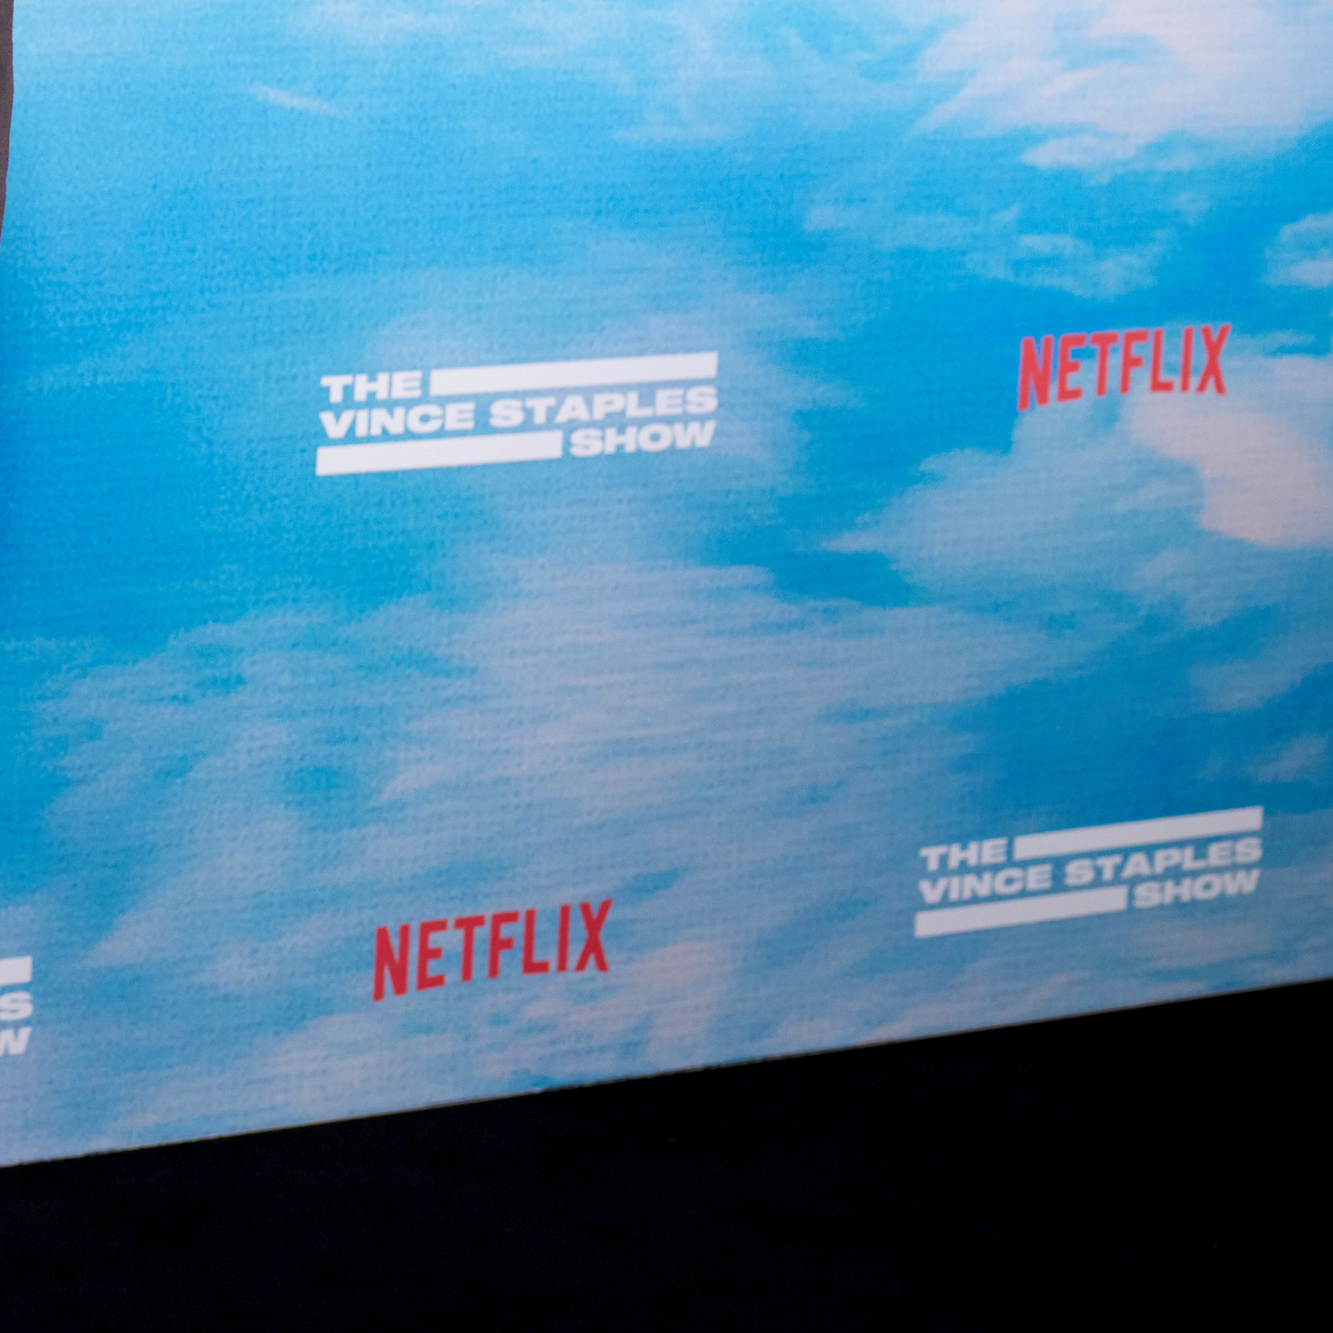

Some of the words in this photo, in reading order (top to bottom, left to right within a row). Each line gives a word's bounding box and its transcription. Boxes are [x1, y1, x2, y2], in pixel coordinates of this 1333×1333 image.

[319, 369, 423, 404] THE
[1019, 323, 1232, 410] NETFLIX
[319, 400, 475, 440] VINCE
[489, 384, 719, 430] STAPLES
[569, 419, 718, 458] SHOW
[917, 863, 1052, 905] VINCE
[1064, 837, 1263, 887] STAPLES
[918, 837, 1008, 873] THE
[1132, 868, 1261, 909] SHOW
[372, 899, 613, 1002] NETFLIX
